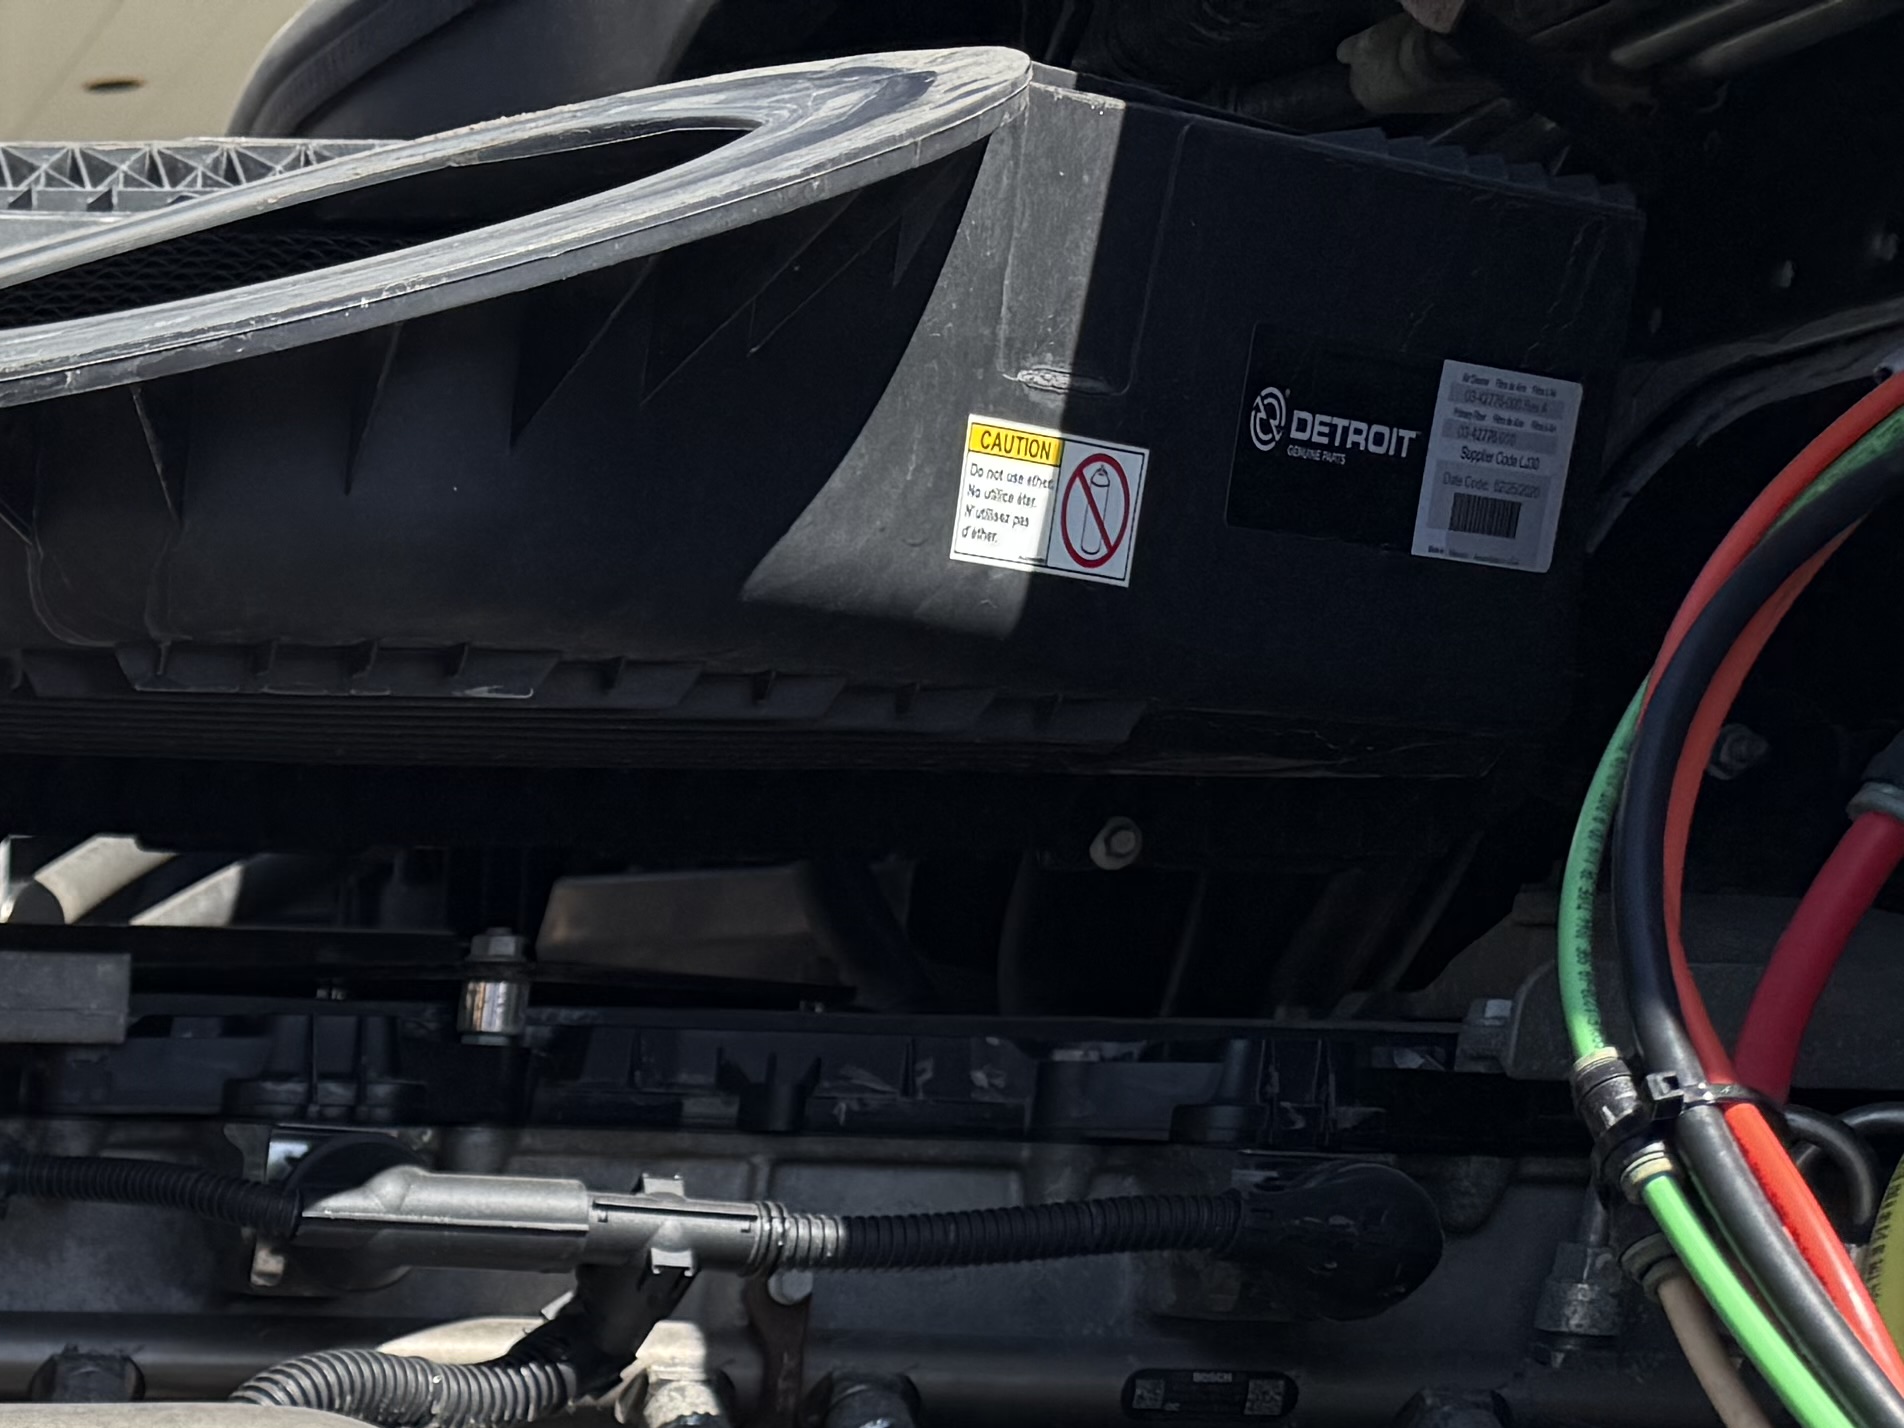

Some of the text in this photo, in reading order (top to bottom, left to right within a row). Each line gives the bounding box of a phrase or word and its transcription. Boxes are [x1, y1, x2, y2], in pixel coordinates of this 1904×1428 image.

[1290, 410, 1416, 457] DETROIT
[981, 431, 1051, 460] CAUTION
[1322, 451, 1346, 465] PARTS
[1496, 452, 1517, 467] Code
[970, 463, 1023, 485] Do not use
[967, 485, 980, 498] No
